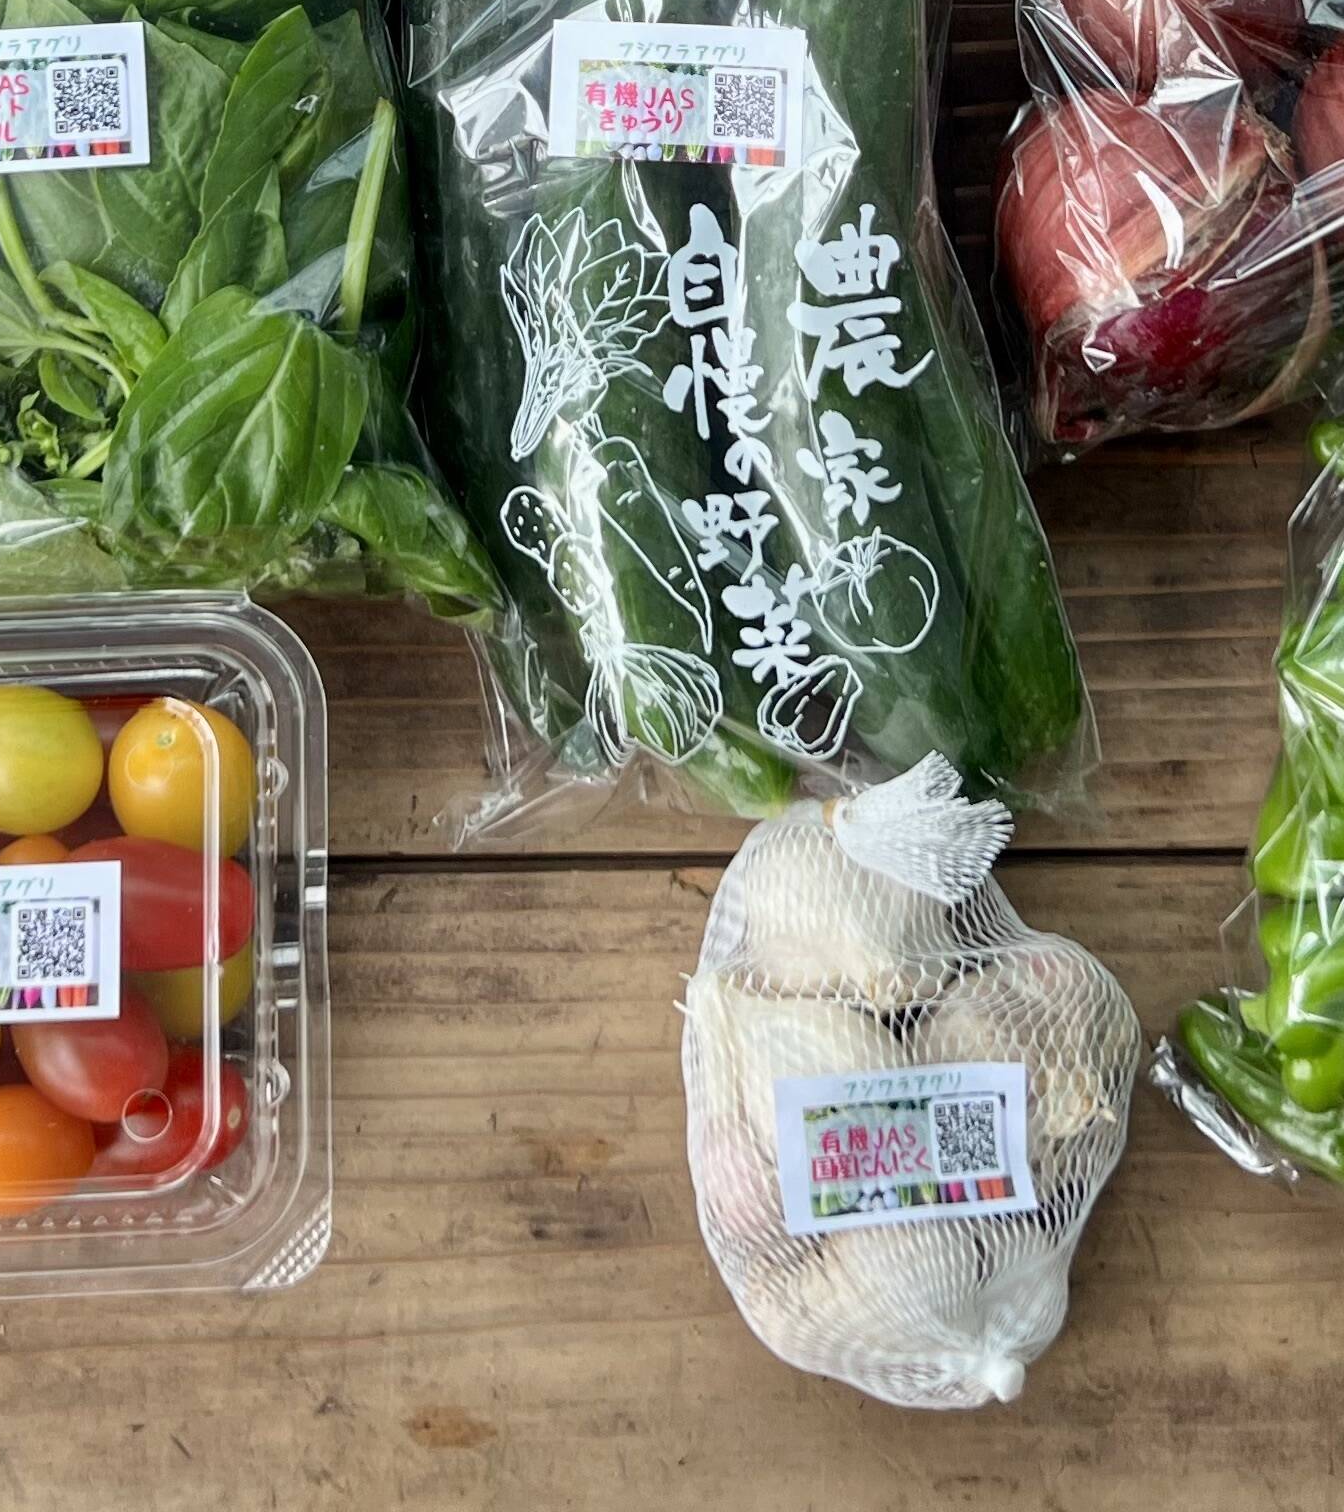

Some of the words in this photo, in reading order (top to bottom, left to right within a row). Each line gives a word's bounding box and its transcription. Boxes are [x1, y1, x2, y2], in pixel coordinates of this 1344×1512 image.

[619, 42, 746, 62] フジワラアグリ
[585, 82, 695, 109] 有機JAS
[600, 111, 683, 133] きゅうり
[786, 204, 934, 525] 農家
[661, 203, 817, 685] 自慢の野菜
[845, 1072, 962, 1096] フジワラアグリ
[820, 1125, 917, 1153] 有機JAS
